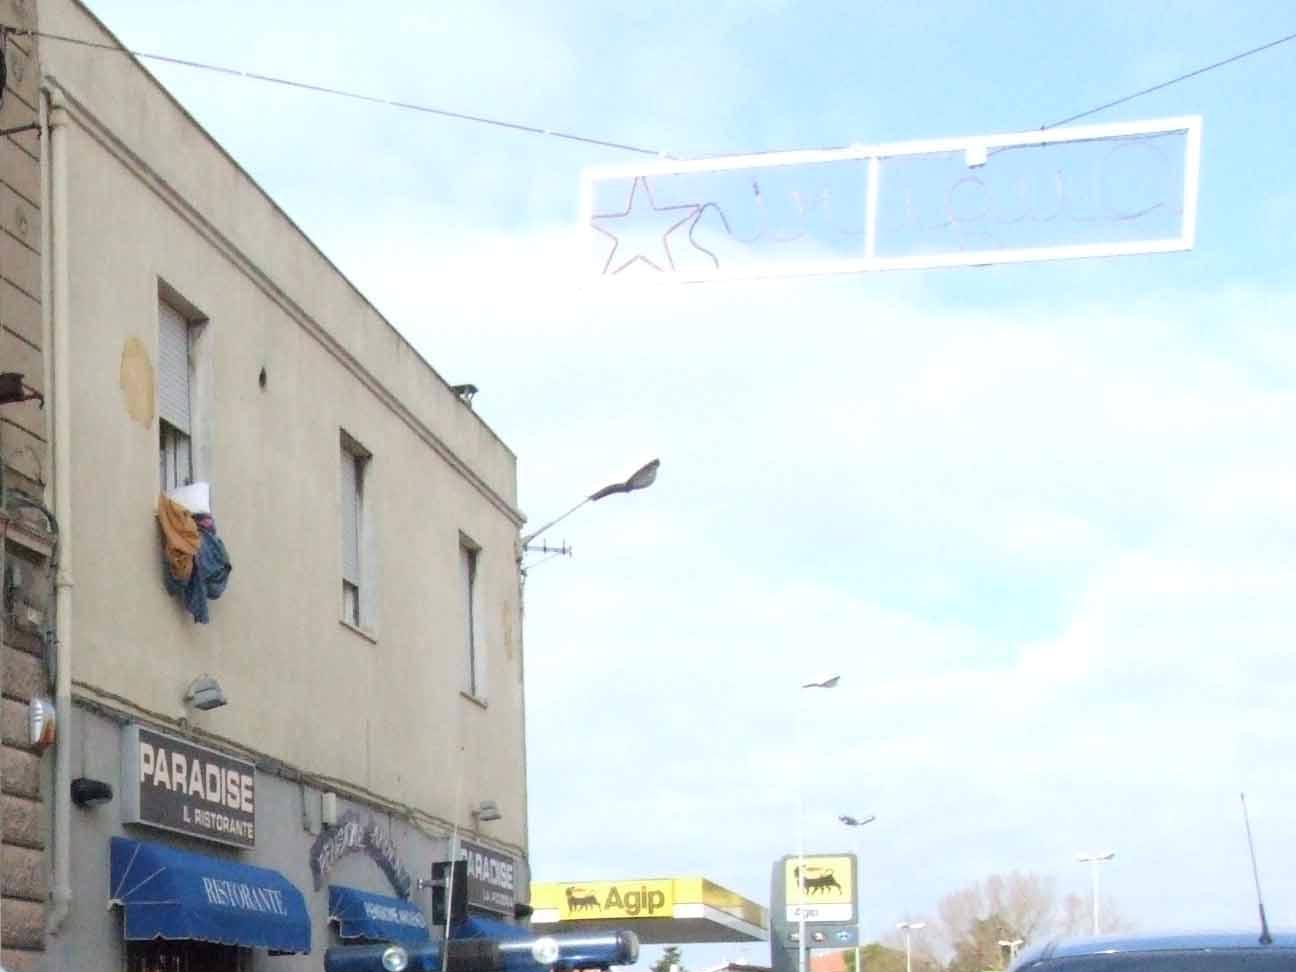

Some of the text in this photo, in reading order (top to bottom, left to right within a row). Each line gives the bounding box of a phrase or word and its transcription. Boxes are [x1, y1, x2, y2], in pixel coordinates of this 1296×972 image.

[140, 742, 253, 813] PARADISE
[194, 808, 254, 839] RISTORANTE
[202, 877, 287, 916] RISTORANTE
[604, 886, 665, 915] Agip
